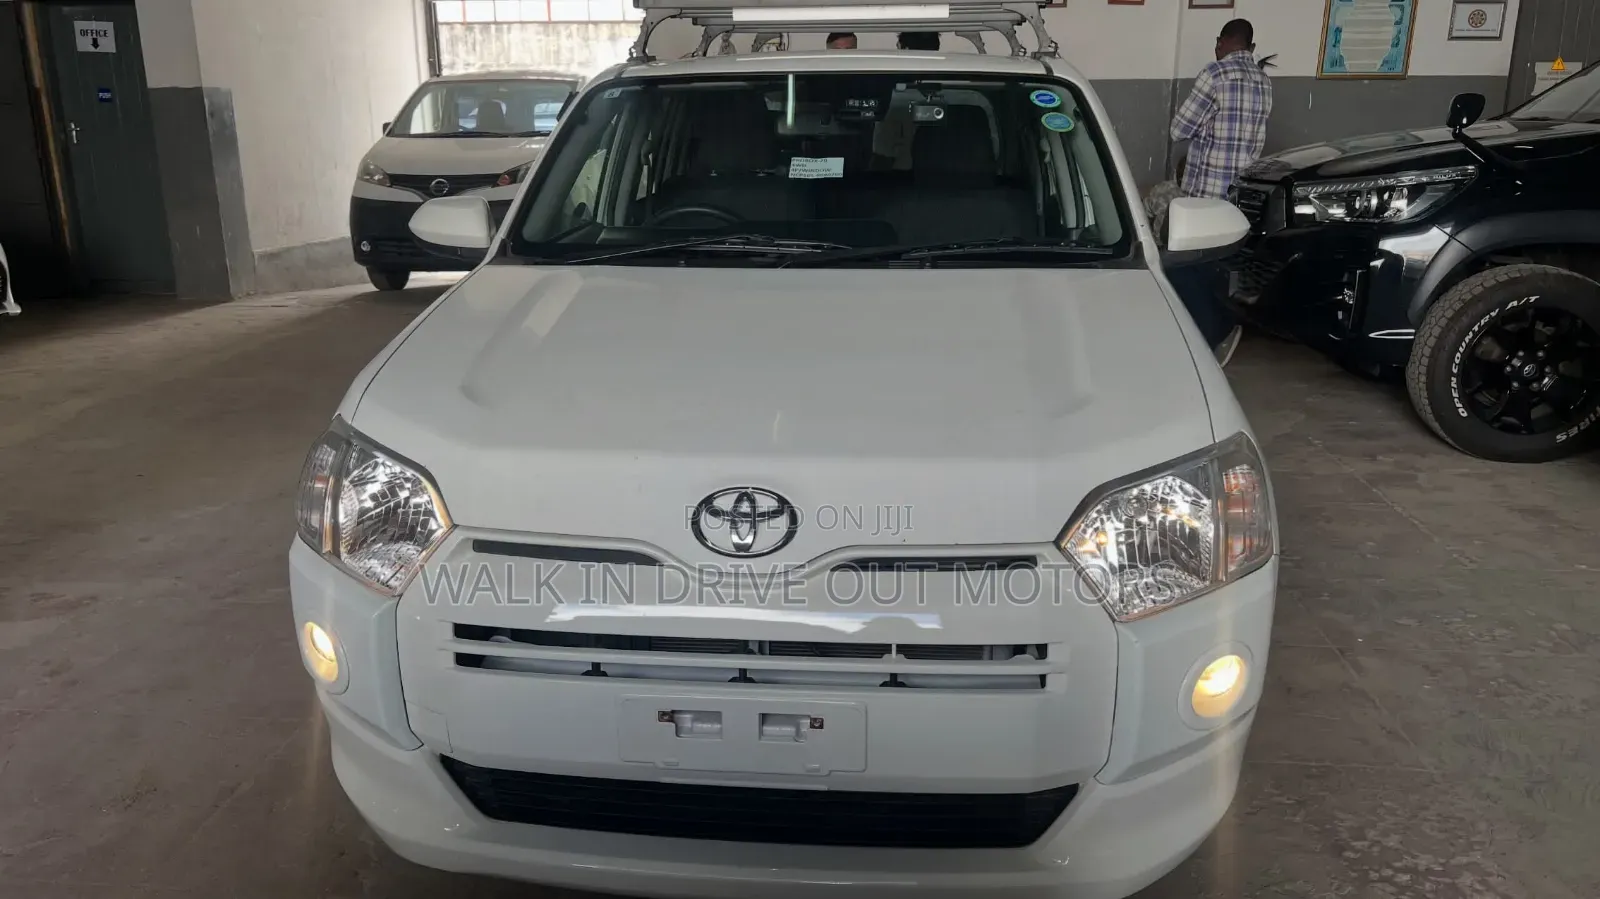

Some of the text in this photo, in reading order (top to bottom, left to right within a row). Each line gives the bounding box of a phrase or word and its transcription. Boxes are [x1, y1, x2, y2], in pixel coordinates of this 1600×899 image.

[80, 29, 109, 37] OFFICE
[1451, 295, 1541, 418] OPEN COUNTRY A/T
